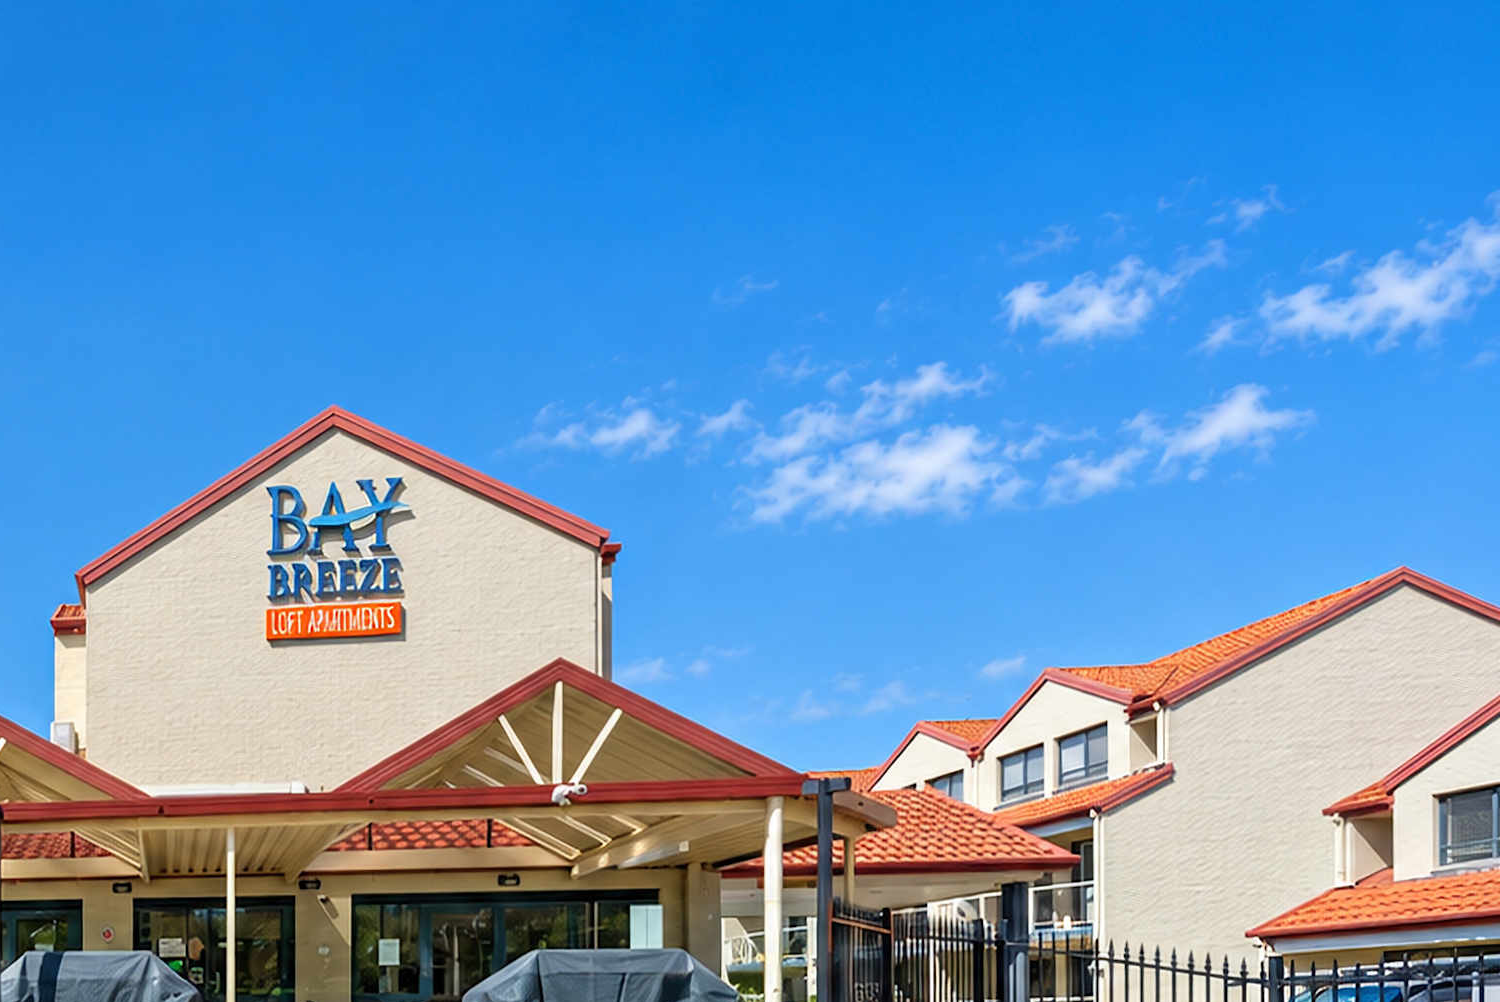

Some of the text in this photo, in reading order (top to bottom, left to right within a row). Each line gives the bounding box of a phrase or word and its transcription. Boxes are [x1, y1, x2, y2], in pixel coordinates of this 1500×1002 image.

[266, 477, 404, 555] BAY
[266, 557, 404, 601] BREEZE
[271, 605, 396, 636] LOFT APARTMENTS
